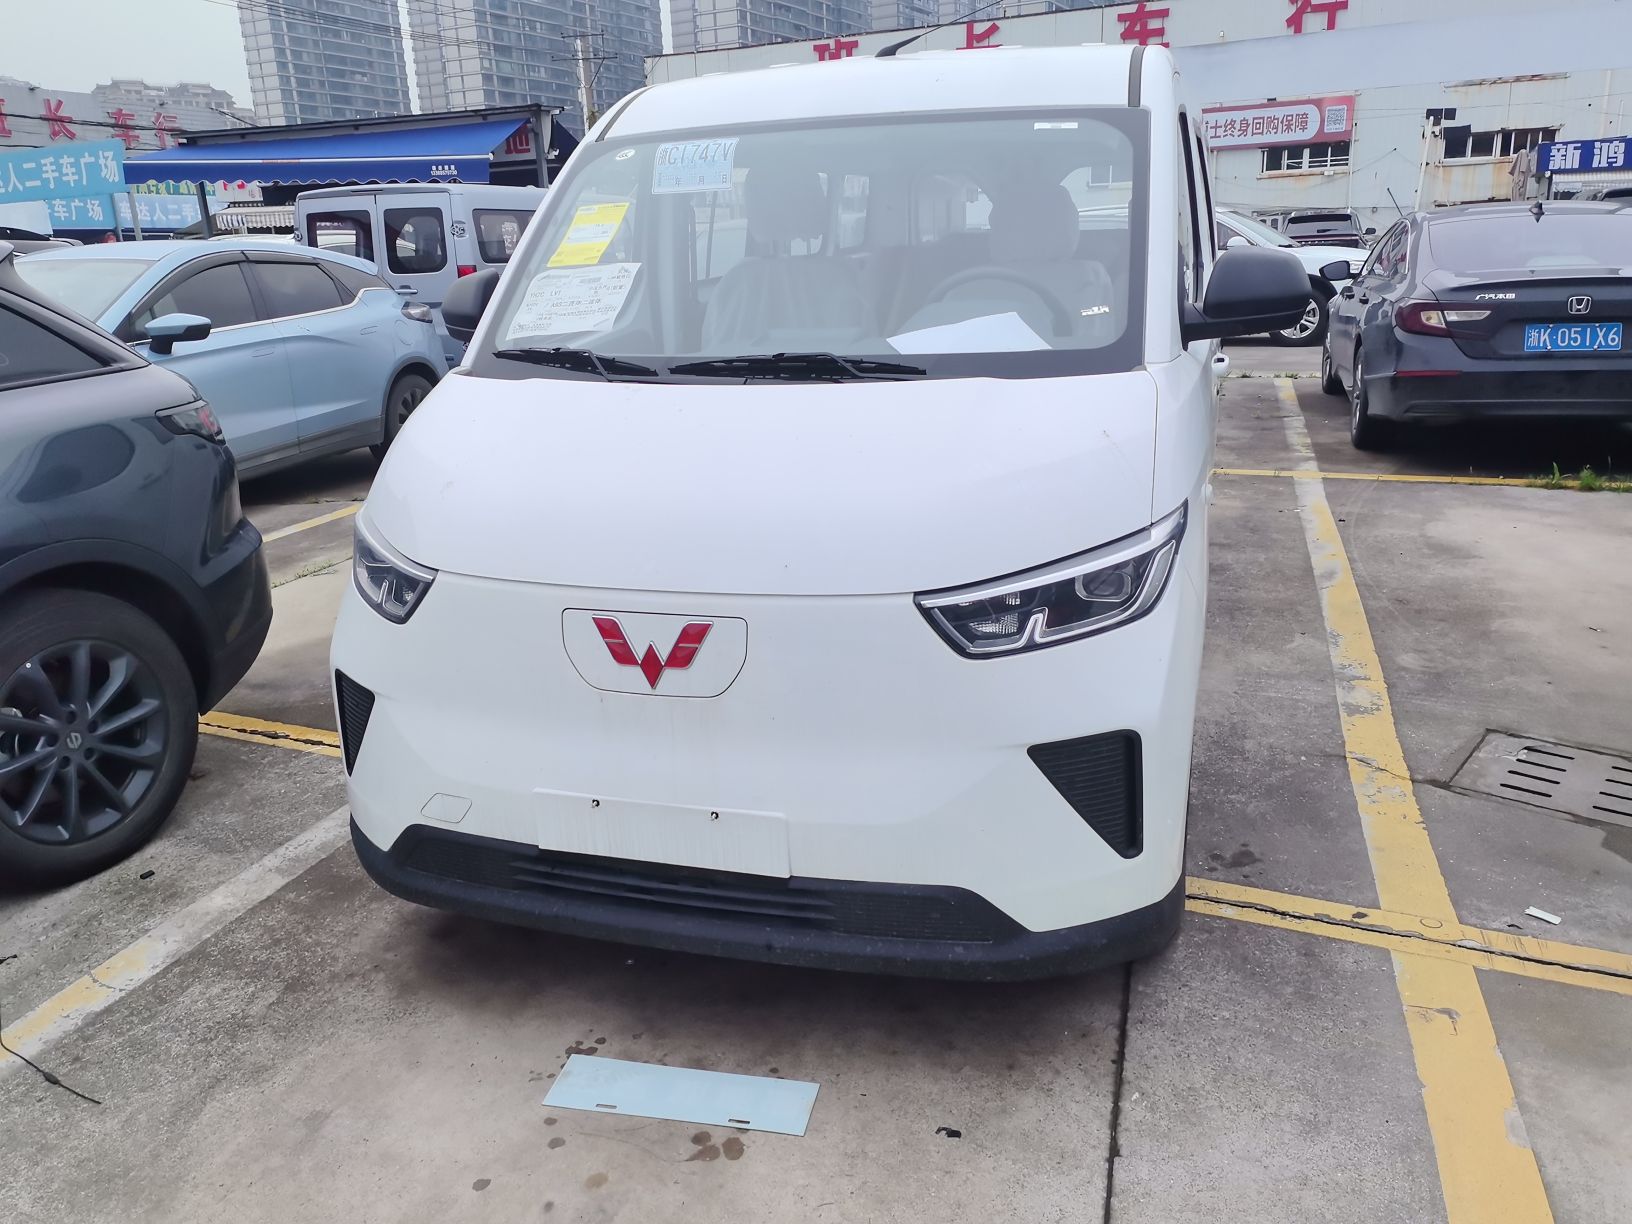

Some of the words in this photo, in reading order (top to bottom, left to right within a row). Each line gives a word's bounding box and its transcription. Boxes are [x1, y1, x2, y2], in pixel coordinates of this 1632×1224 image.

[1549, 141, 1625, 170] 新鸿
[48, 198, 103, 221] 车广场
[119, 201, 201, 222] 车达人二手
